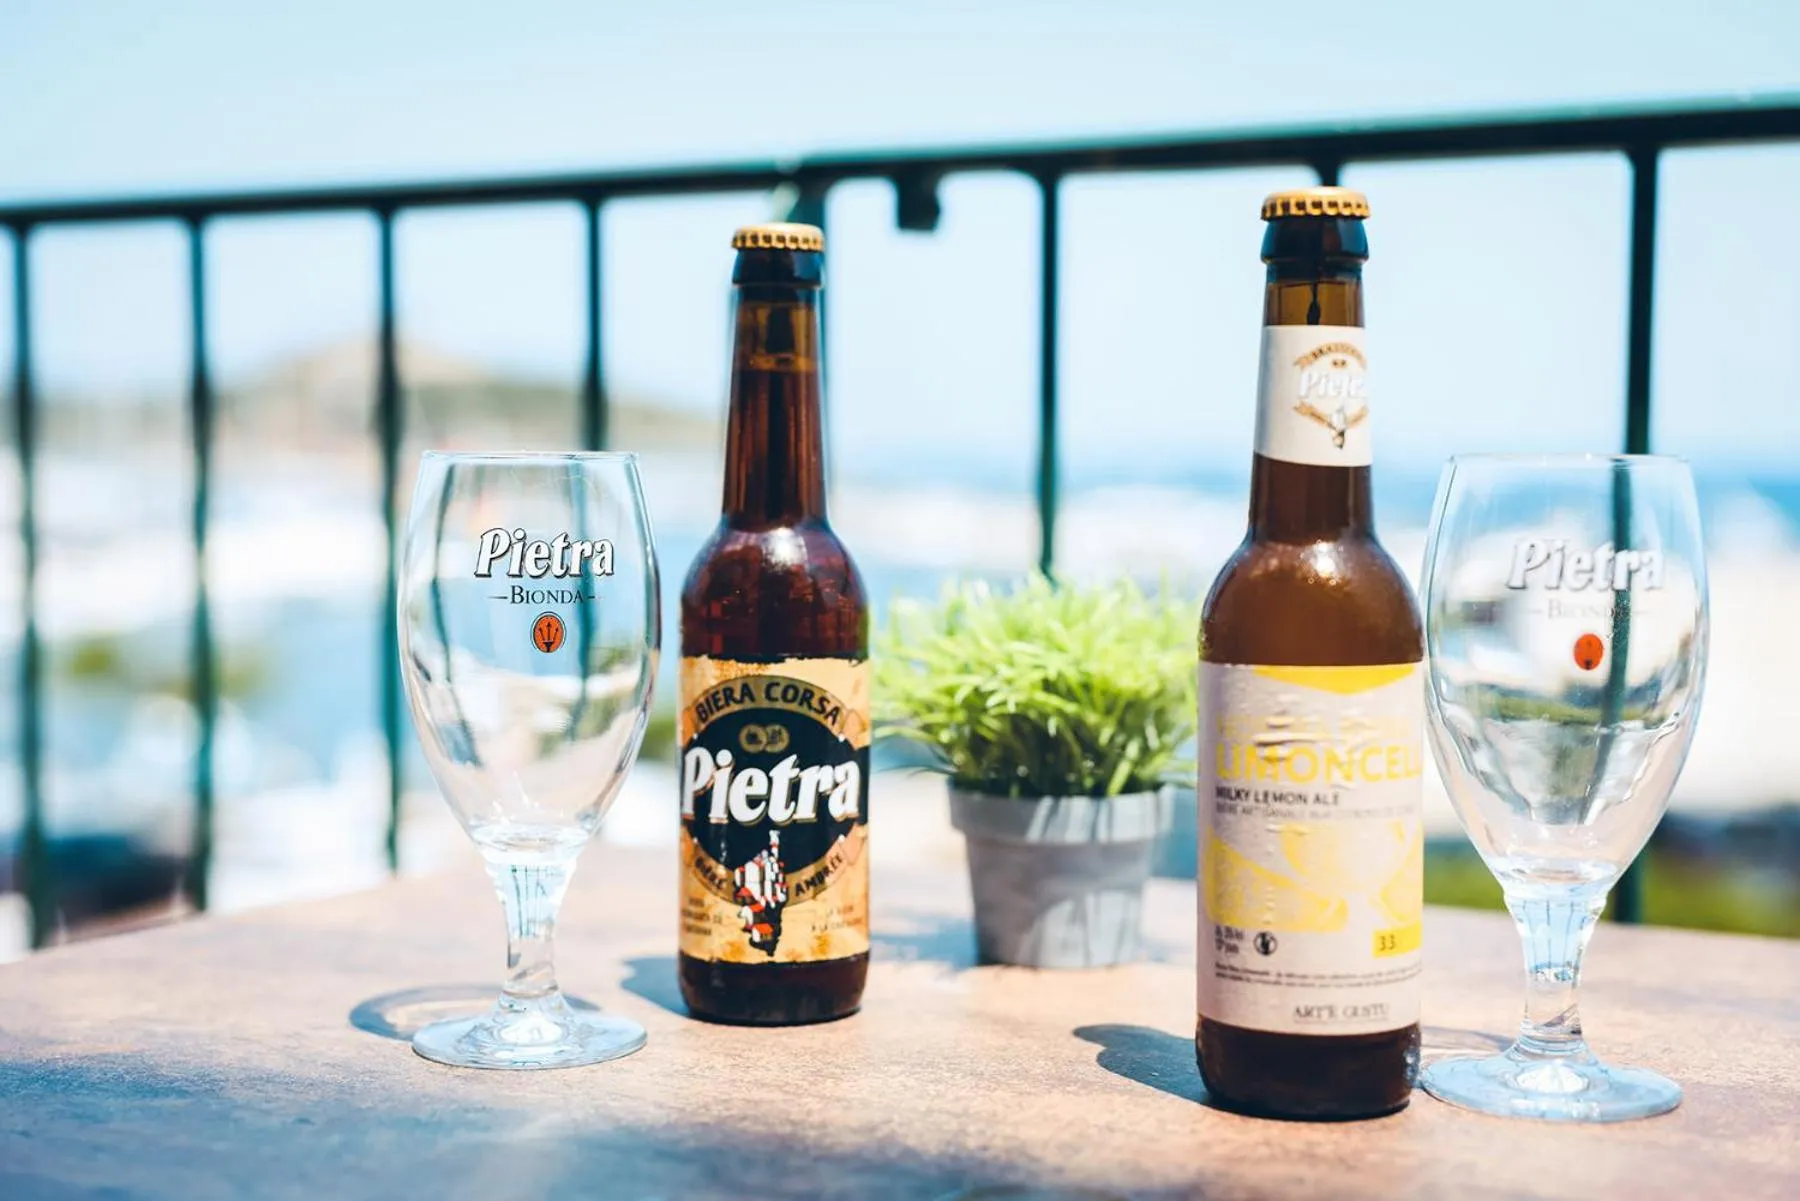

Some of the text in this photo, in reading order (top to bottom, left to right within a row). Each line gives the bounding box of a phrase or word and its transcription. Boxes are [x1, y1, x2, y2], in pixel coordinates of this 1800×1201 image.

[474, 527, 615, 579] Pietra
[1505, 539, 1665, 592] Pietra
[695, 682, 842, 727] BIERA CORSA
[681, 747, 862, 826] Pietra
[1254, 789, 1308, 805] LEMON
[1313, 792, 1340, 806] ALE
[1379, 934, 1397, 951] 33
